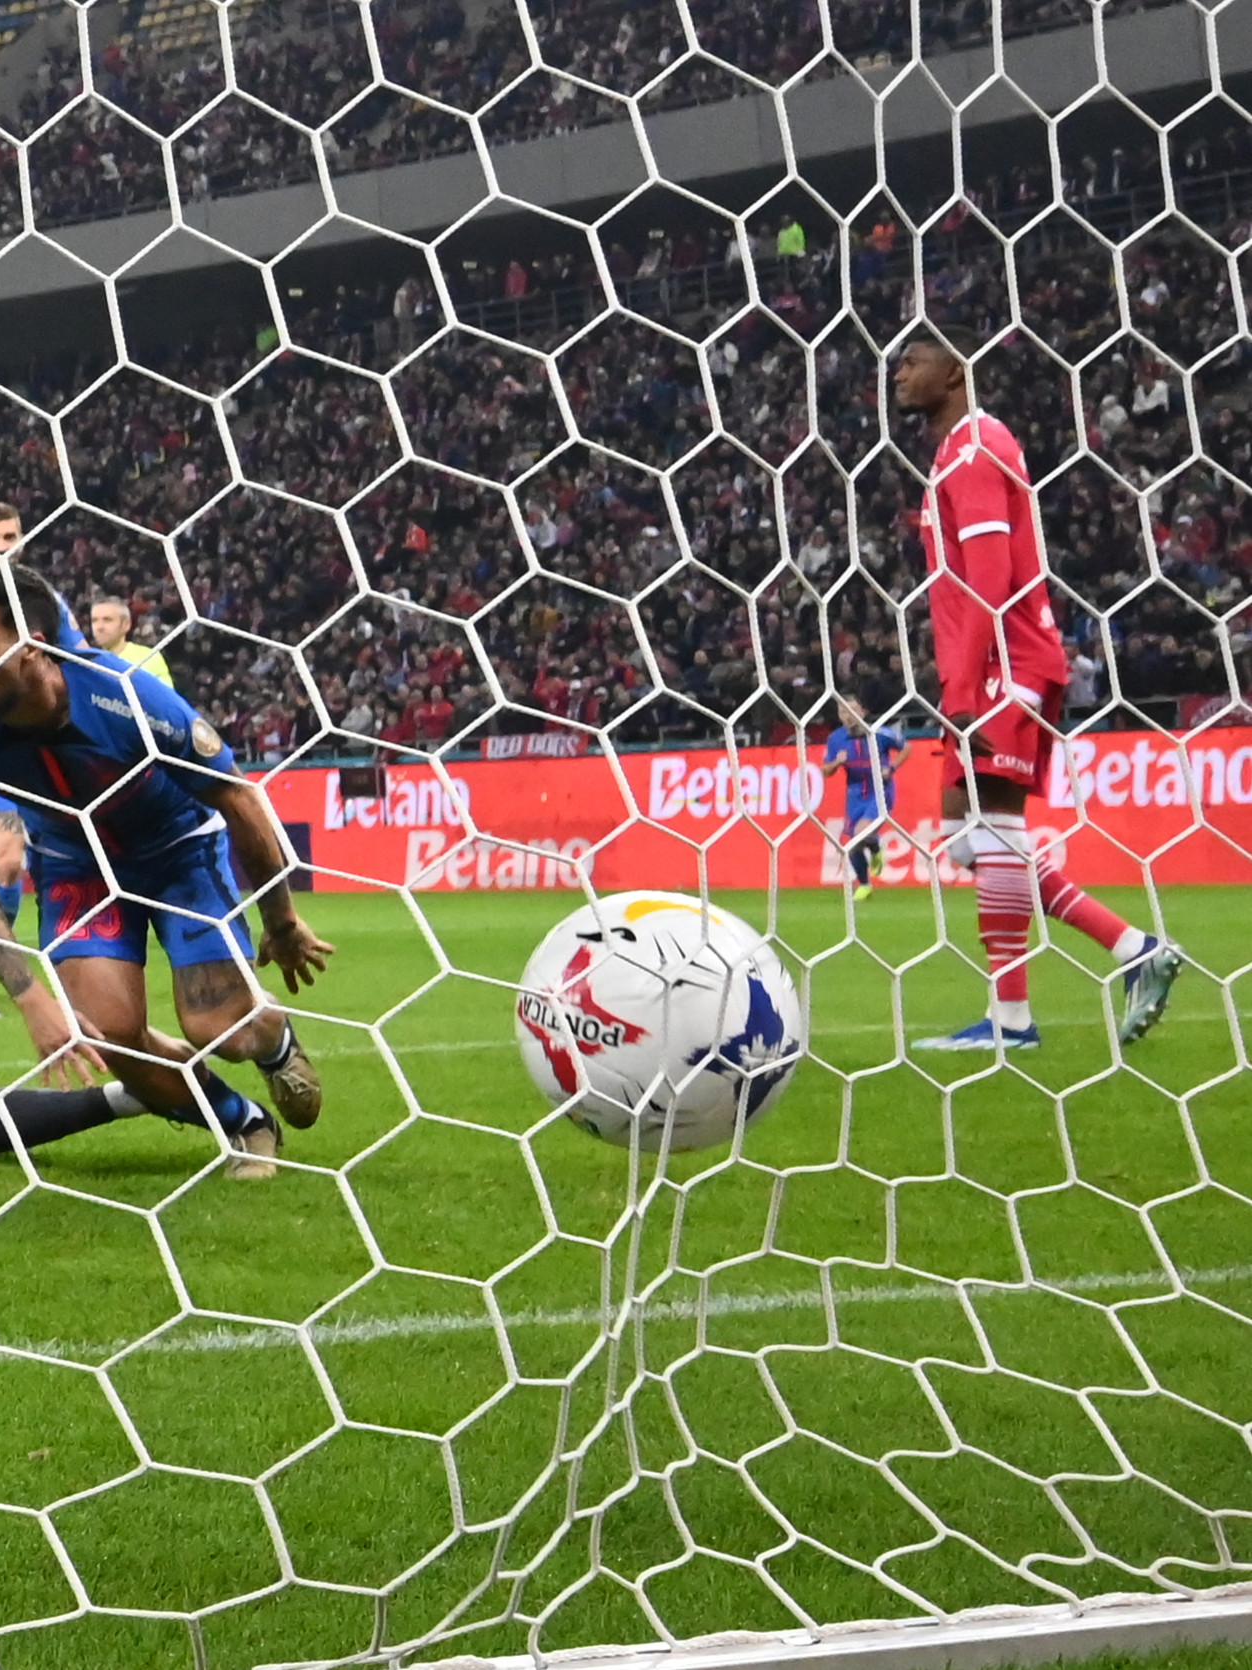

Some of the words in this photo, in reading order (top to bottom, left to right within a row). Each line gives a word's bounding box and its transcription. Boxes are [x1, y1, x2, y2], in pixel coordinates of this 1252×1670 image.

[487, 735, 523, 759] RED
[1048, 739, 1252, 808] Betano
[649, 756, 824, 820] Betano
[405, 830, 595, 890] Betano
